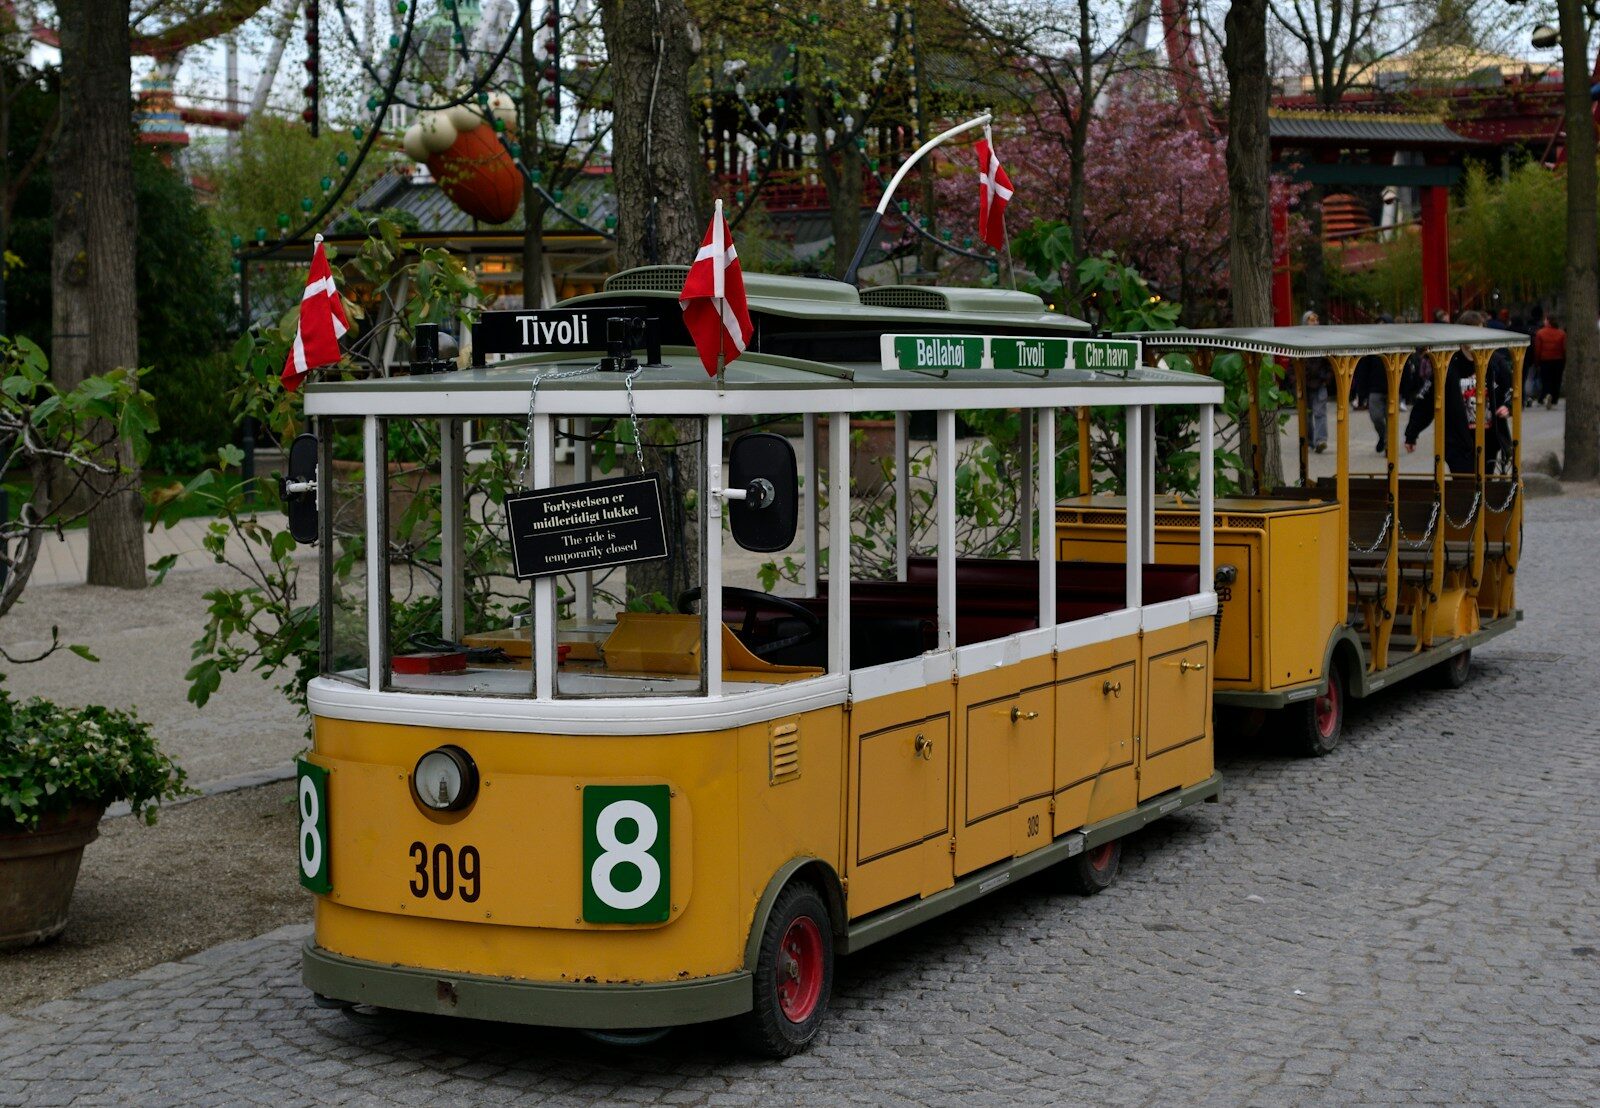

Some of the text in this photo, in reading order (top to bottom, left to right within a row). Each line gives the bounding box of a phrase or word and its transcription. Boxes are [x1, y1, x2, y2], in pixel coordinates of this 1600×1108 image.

[515, 314, 589, 346] Tivoli
[916, 338, 965, 368] Bellahøj
[1016, 340, 1045, 367] Tivoli
[542, 494, 625, 513] Forlystelsen er
[533, 505, 639, 530] midlertidigt lukket
[544, 540, 638, 563] temporarily closed
[561, 530, 616, 547] The ride is
[299, 774, 322, 879] 8
[1027, 814, 1040, 838] 309
[590, 799, 661, 910] 8
[409, 840, 481, 903] 309
